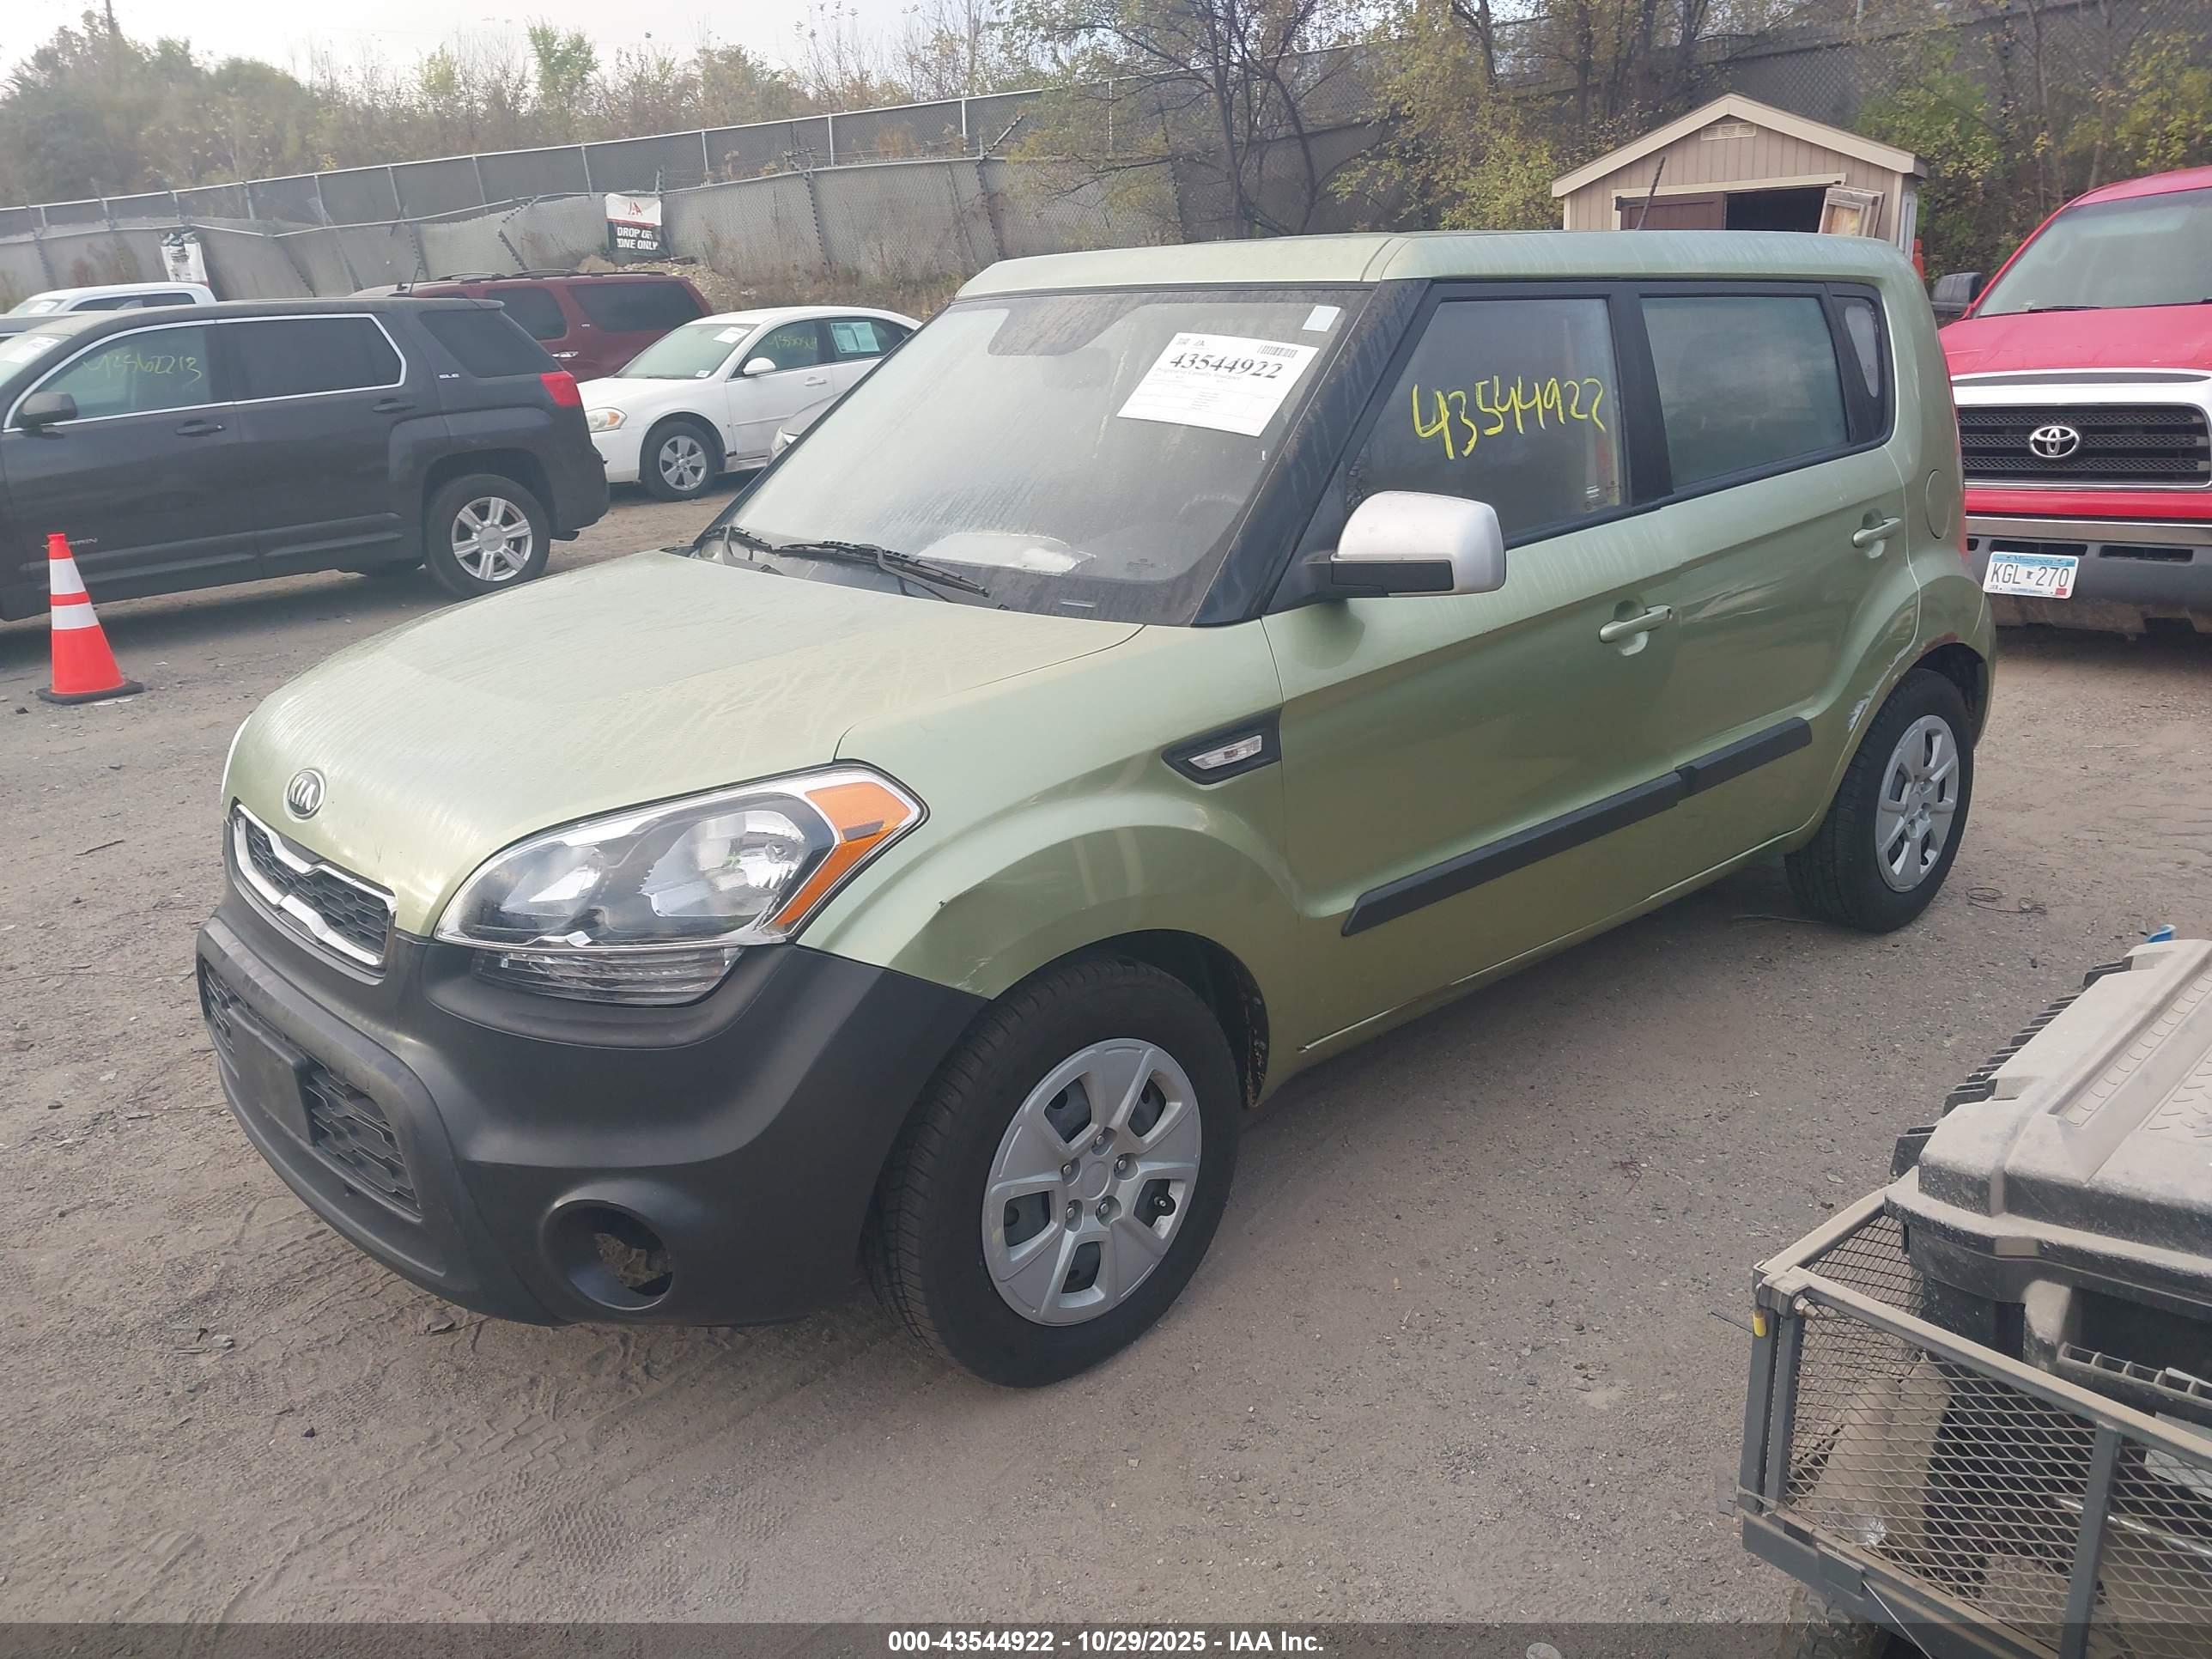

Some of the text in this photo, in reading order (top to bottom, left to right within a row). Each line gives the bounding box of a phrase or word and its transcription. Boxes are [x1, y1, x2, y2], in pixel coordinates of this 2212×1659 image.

[617, 227, 641, 238] DROP
[637, 240, 659, 250] ONLY
[1170, 352, 1285, 379] 43544922
[1411, 375, 1607, 459] 43544922
[1990, 562, 2070, 587] KGL 270
[288, 776, 317, 811] KIA
